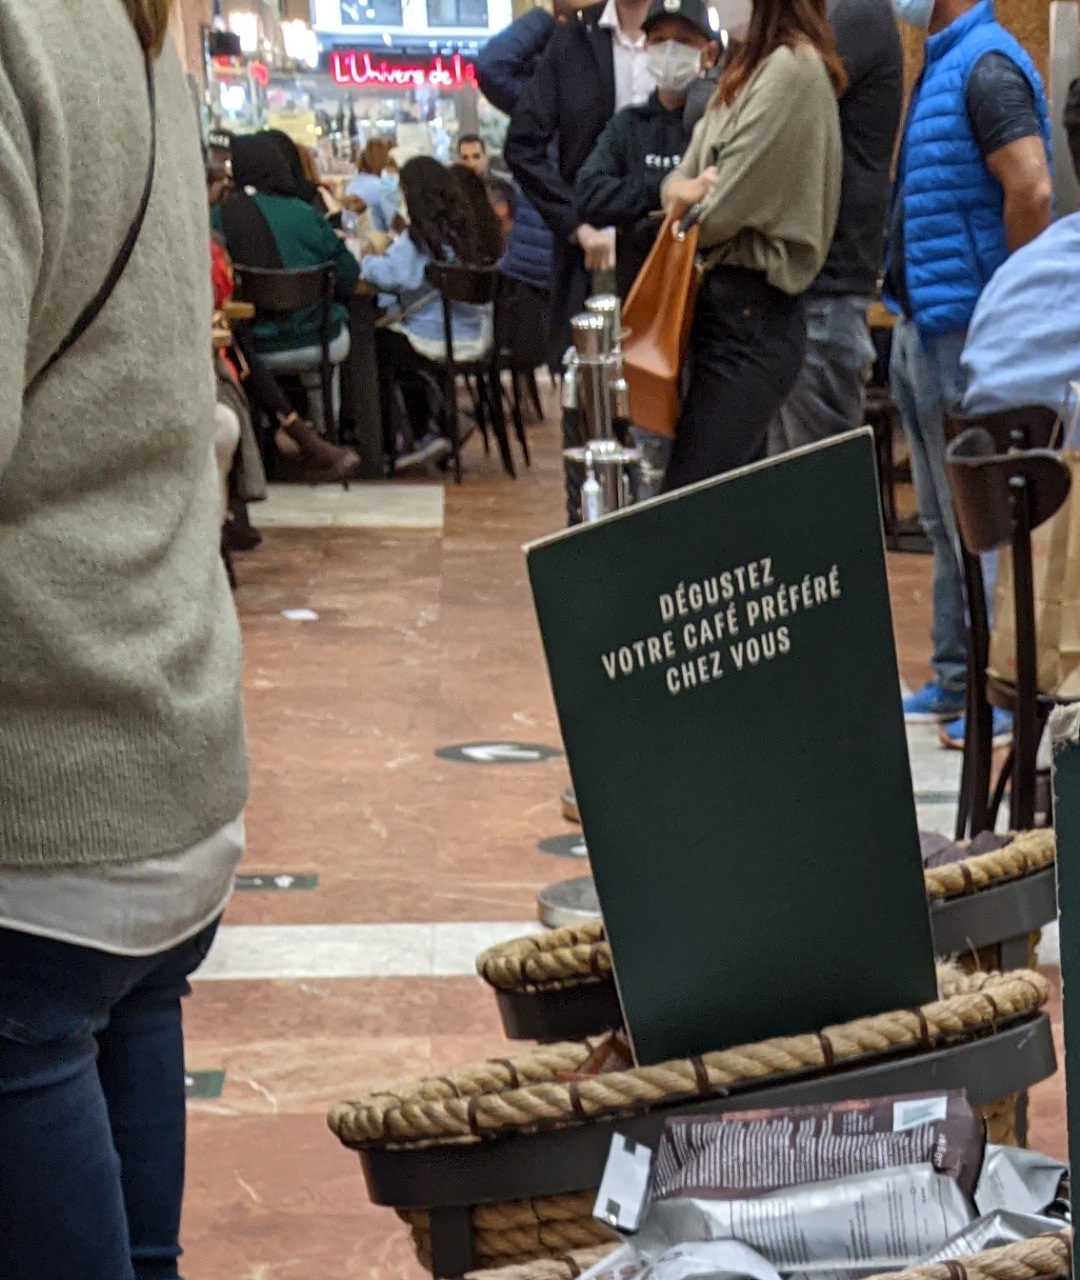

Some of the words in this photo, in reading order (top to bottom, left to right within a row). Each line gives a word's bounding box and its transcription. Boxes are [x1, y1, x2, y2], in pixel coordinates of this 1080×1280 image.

[331, 53, 424, 84] L'Univers
[429, 57, 452, 85] de
[601, 631, 677, 681] VOTRE
[683, 601, 740, 651] CAFÉ
[746, 564, 842, 628] PRÉFÉRÉ
[659, 557, 775, 623] DÉGUSTEZ
[666, 651, 724, 696] CHEZ
[730, 626, 792, 671] VOUS
